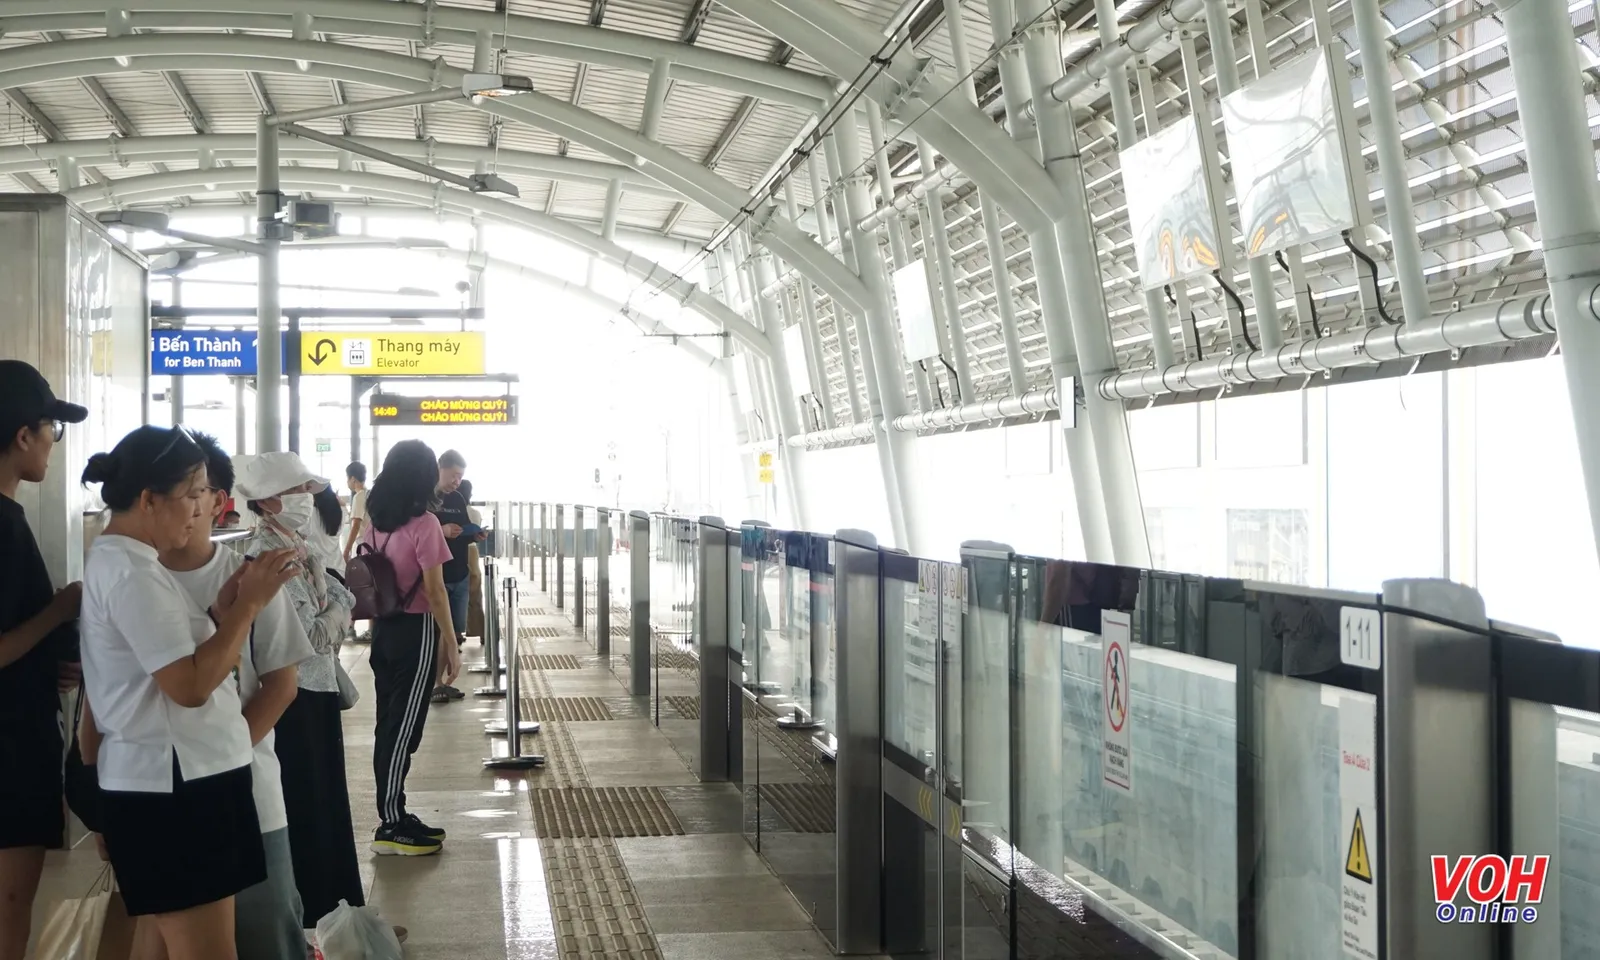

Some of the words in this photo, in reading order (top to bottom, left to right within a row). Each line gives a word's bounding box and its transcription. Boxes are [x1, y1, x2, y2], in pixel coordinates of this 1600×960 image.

[159, 335, 190, 352] Bến
[193, 336, 242, 352] Thành
[377, 338, 424, 355] Thang
[429, 338, 461, 355] máy
[164, 356, 181, 368] for
[183, 356, 205, 368] Ben
[207, 356, 242, 368] Thanh
[377, 357, 420, 368] Elevator
[373, 406, 398, 416] 14:49
